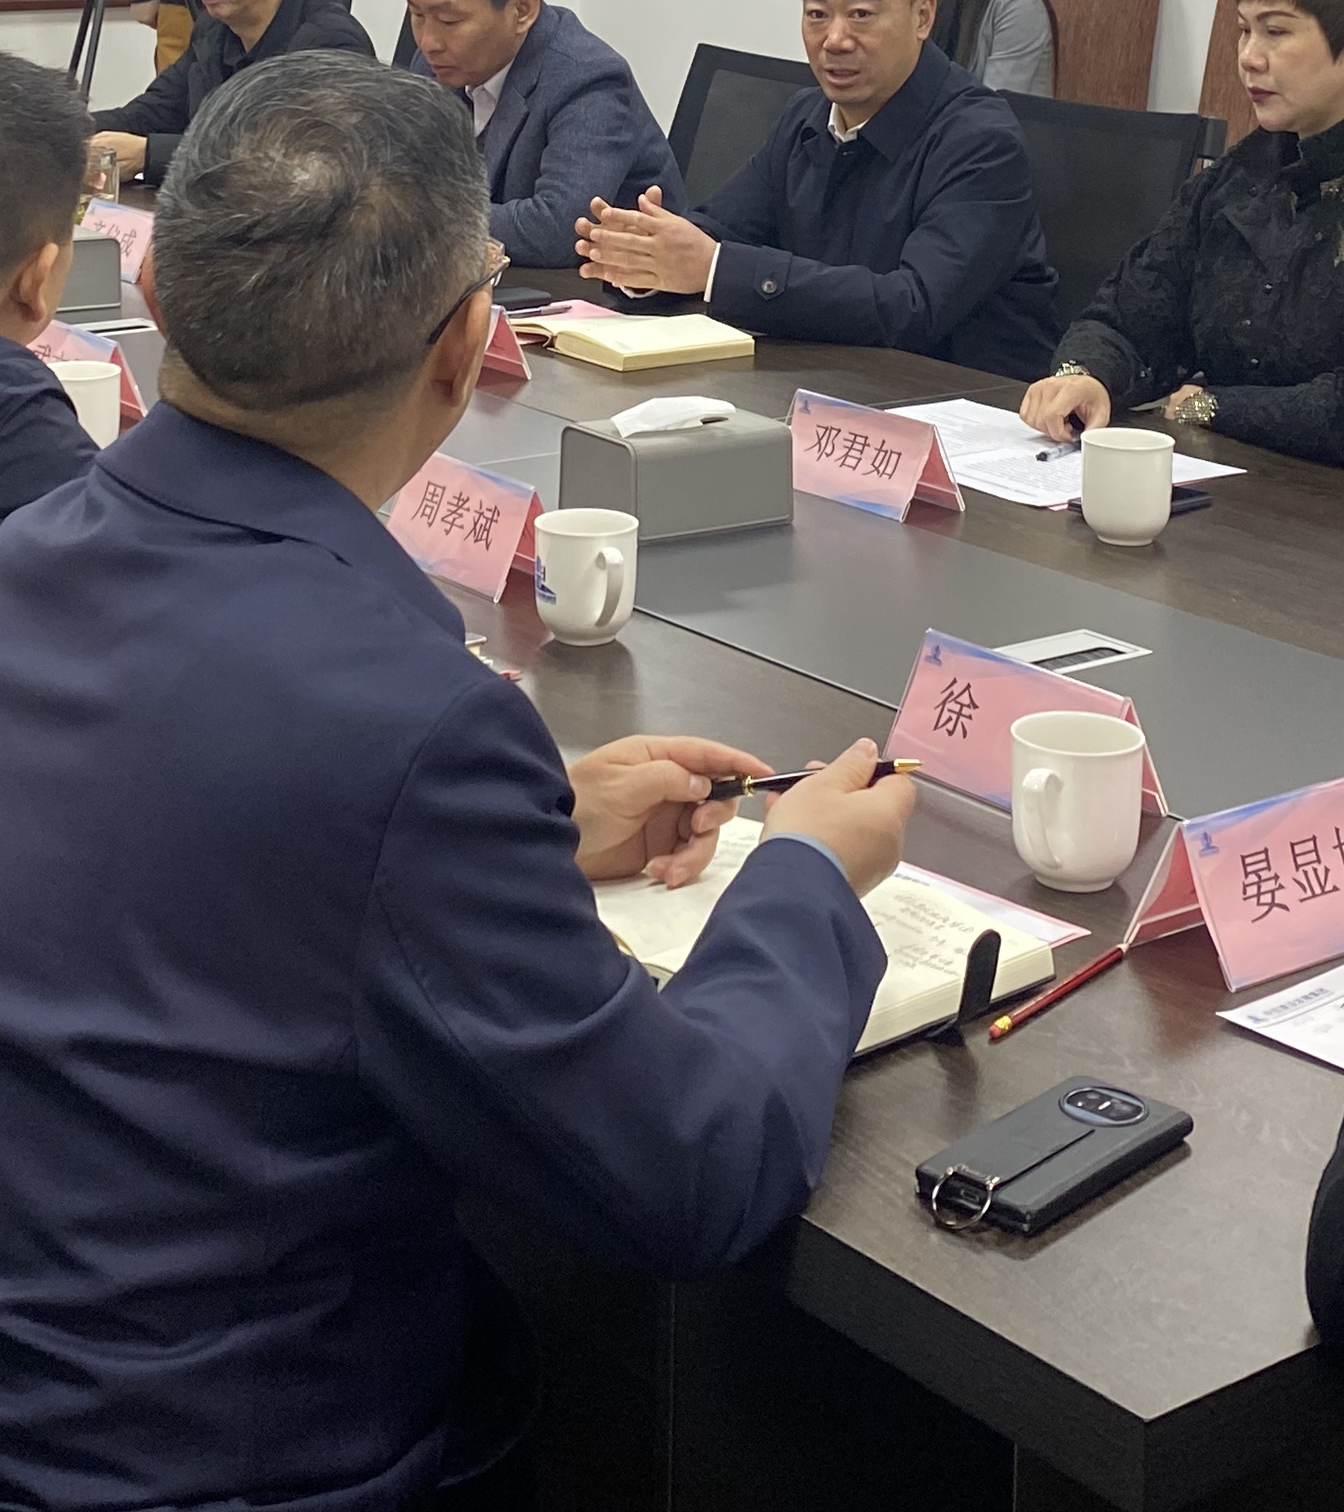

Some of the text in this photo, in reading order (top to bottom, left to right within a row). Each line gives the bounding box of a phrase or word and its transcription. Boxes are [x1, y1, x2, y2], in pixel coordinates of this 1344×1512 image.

[803, 424, 902, 480] 邓君如
[411, 480, 500, 551] 周孝斌
[933, 676, 980, 739] 徐
